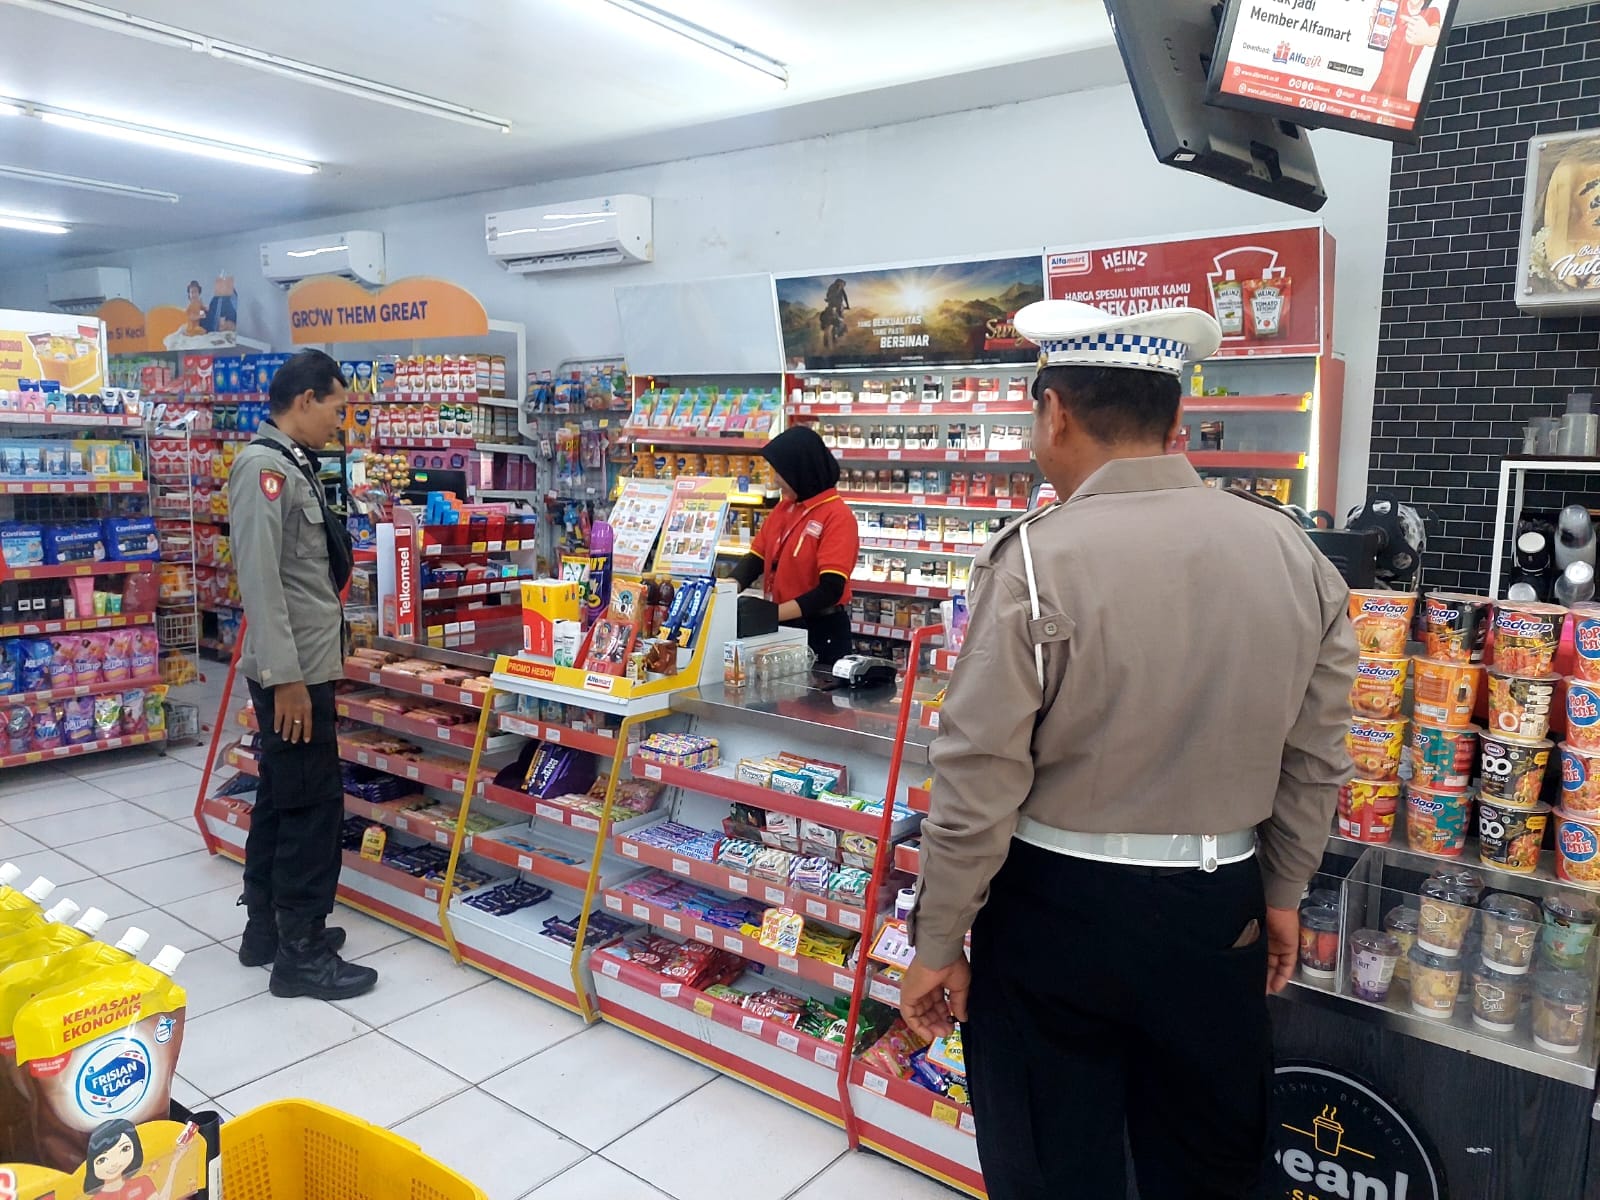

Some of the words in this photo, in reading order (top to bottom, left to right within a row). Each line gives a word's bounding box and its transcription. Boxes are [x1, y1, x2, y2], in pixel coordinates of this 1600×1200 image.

[1250, 6, 1300, 29] Member
[1300, 18, 1352, 42] Alfamart
[1288, 51, 1322, 68] Alfagift
[1051, 256, 1086, 266] Alfamart
[1101, 250, 1148, 270] HEINZ
[1064, 290, 1094, 302] HARGA
[1095, 288, 1129, 300] SPESIAL
[1130, 285, 1160, 298] UNTUK
[1162, 282, 1191, 296] KAMU
[292, 308, 333, 328] GROW
[336, 305, 376, 324] THEM
[380, 300, 428, 322] GREAT
[880, 334, 930, 348] BERSINAR
[1, 524, 41, 538] Confidence
[115, 520, 150, 532] Confidence
[54, 530, 99, 543] Confidence
[400, 546, 411, 617] Telkomsel
[671, 591, 683, 616] OREO
[691, 590, 702, 616] OREO
[1362, 602, 1408, 614] Sedaap
[1496, 616, 1554, 632] Sedaap
[1580, 627, 1600, 641] POP
[508, 661, 531, 675] PROMO
[532, 666, 555, 680] HEBOH
[1357, 666, 1400, 676] Sedaap
[588, 675, 612, 686] Alfamart
[1570, 694, 1589, 706] POP
[1573, 705, 1598, 718] MIE
[1350, 726, 1394, 740] Sedaap
[1482, 754, 1512, 776] 100
[1562, 830, 1584, 844] POP
[1566, 842, 1594, 854] MIE
[62, 992, 141, 1027] KEMASAN
[62, 1002, 142, 1044] EKONOMIS
[92, 1060, 138, 1090] FRISIAN
[102, 1074, 132, 1096] FLAG
[1340, 1092, 1401, 1147] BREWED
